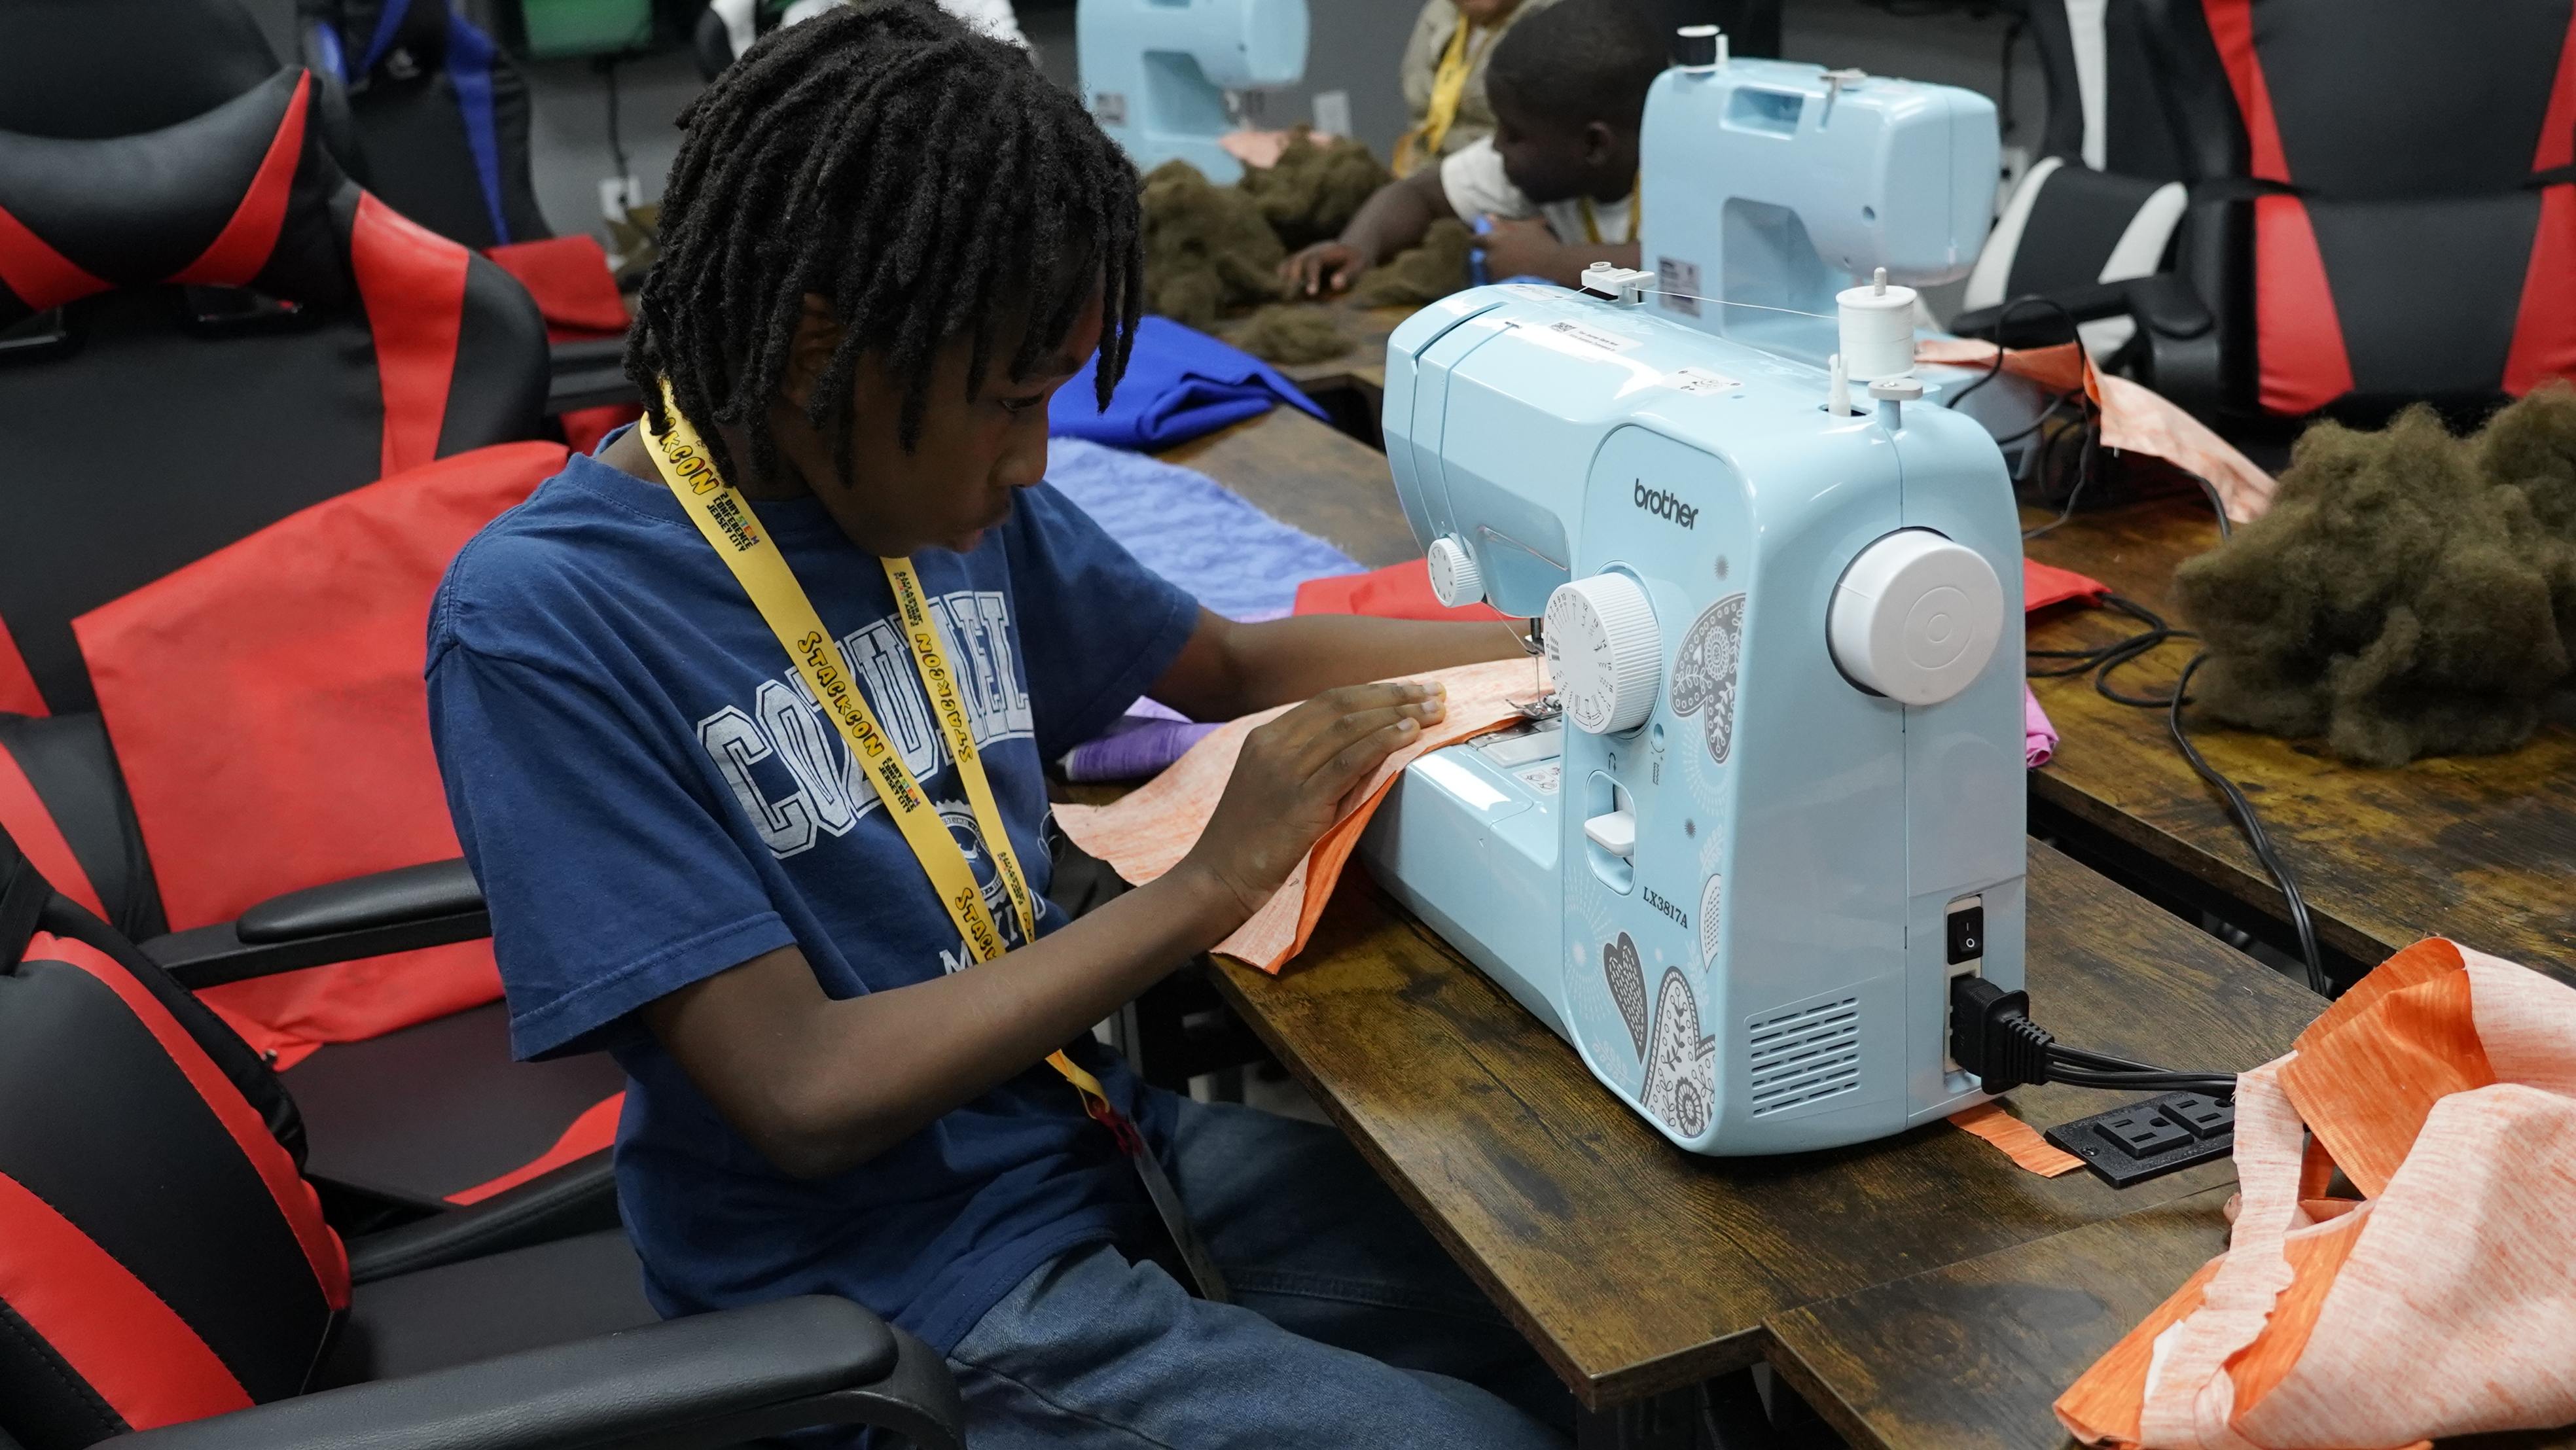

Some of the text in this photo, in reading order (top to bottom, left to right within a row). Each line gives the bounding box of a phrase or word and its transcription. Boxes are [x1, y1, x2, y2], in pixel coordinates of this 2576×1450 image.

[720, 491, 729, 500] 2
[724, 499, 740, 516] DAY
[1634, 478, 1698, 530] brother
[706, 504, 746, 552] JERSEY CITY
[713, 497, 753, 549] CONFERENCE
[798, 631, 885, 758] STACKCON
[915, 633, 973, 763] STACKCON
[878, 766, 911, 813] JERSEY CITY
[882, 760, 916, 811] CONFERENCE
[891, 762, 903, 778] DAY
[1643, 886, 1687, 929] LX3817A
